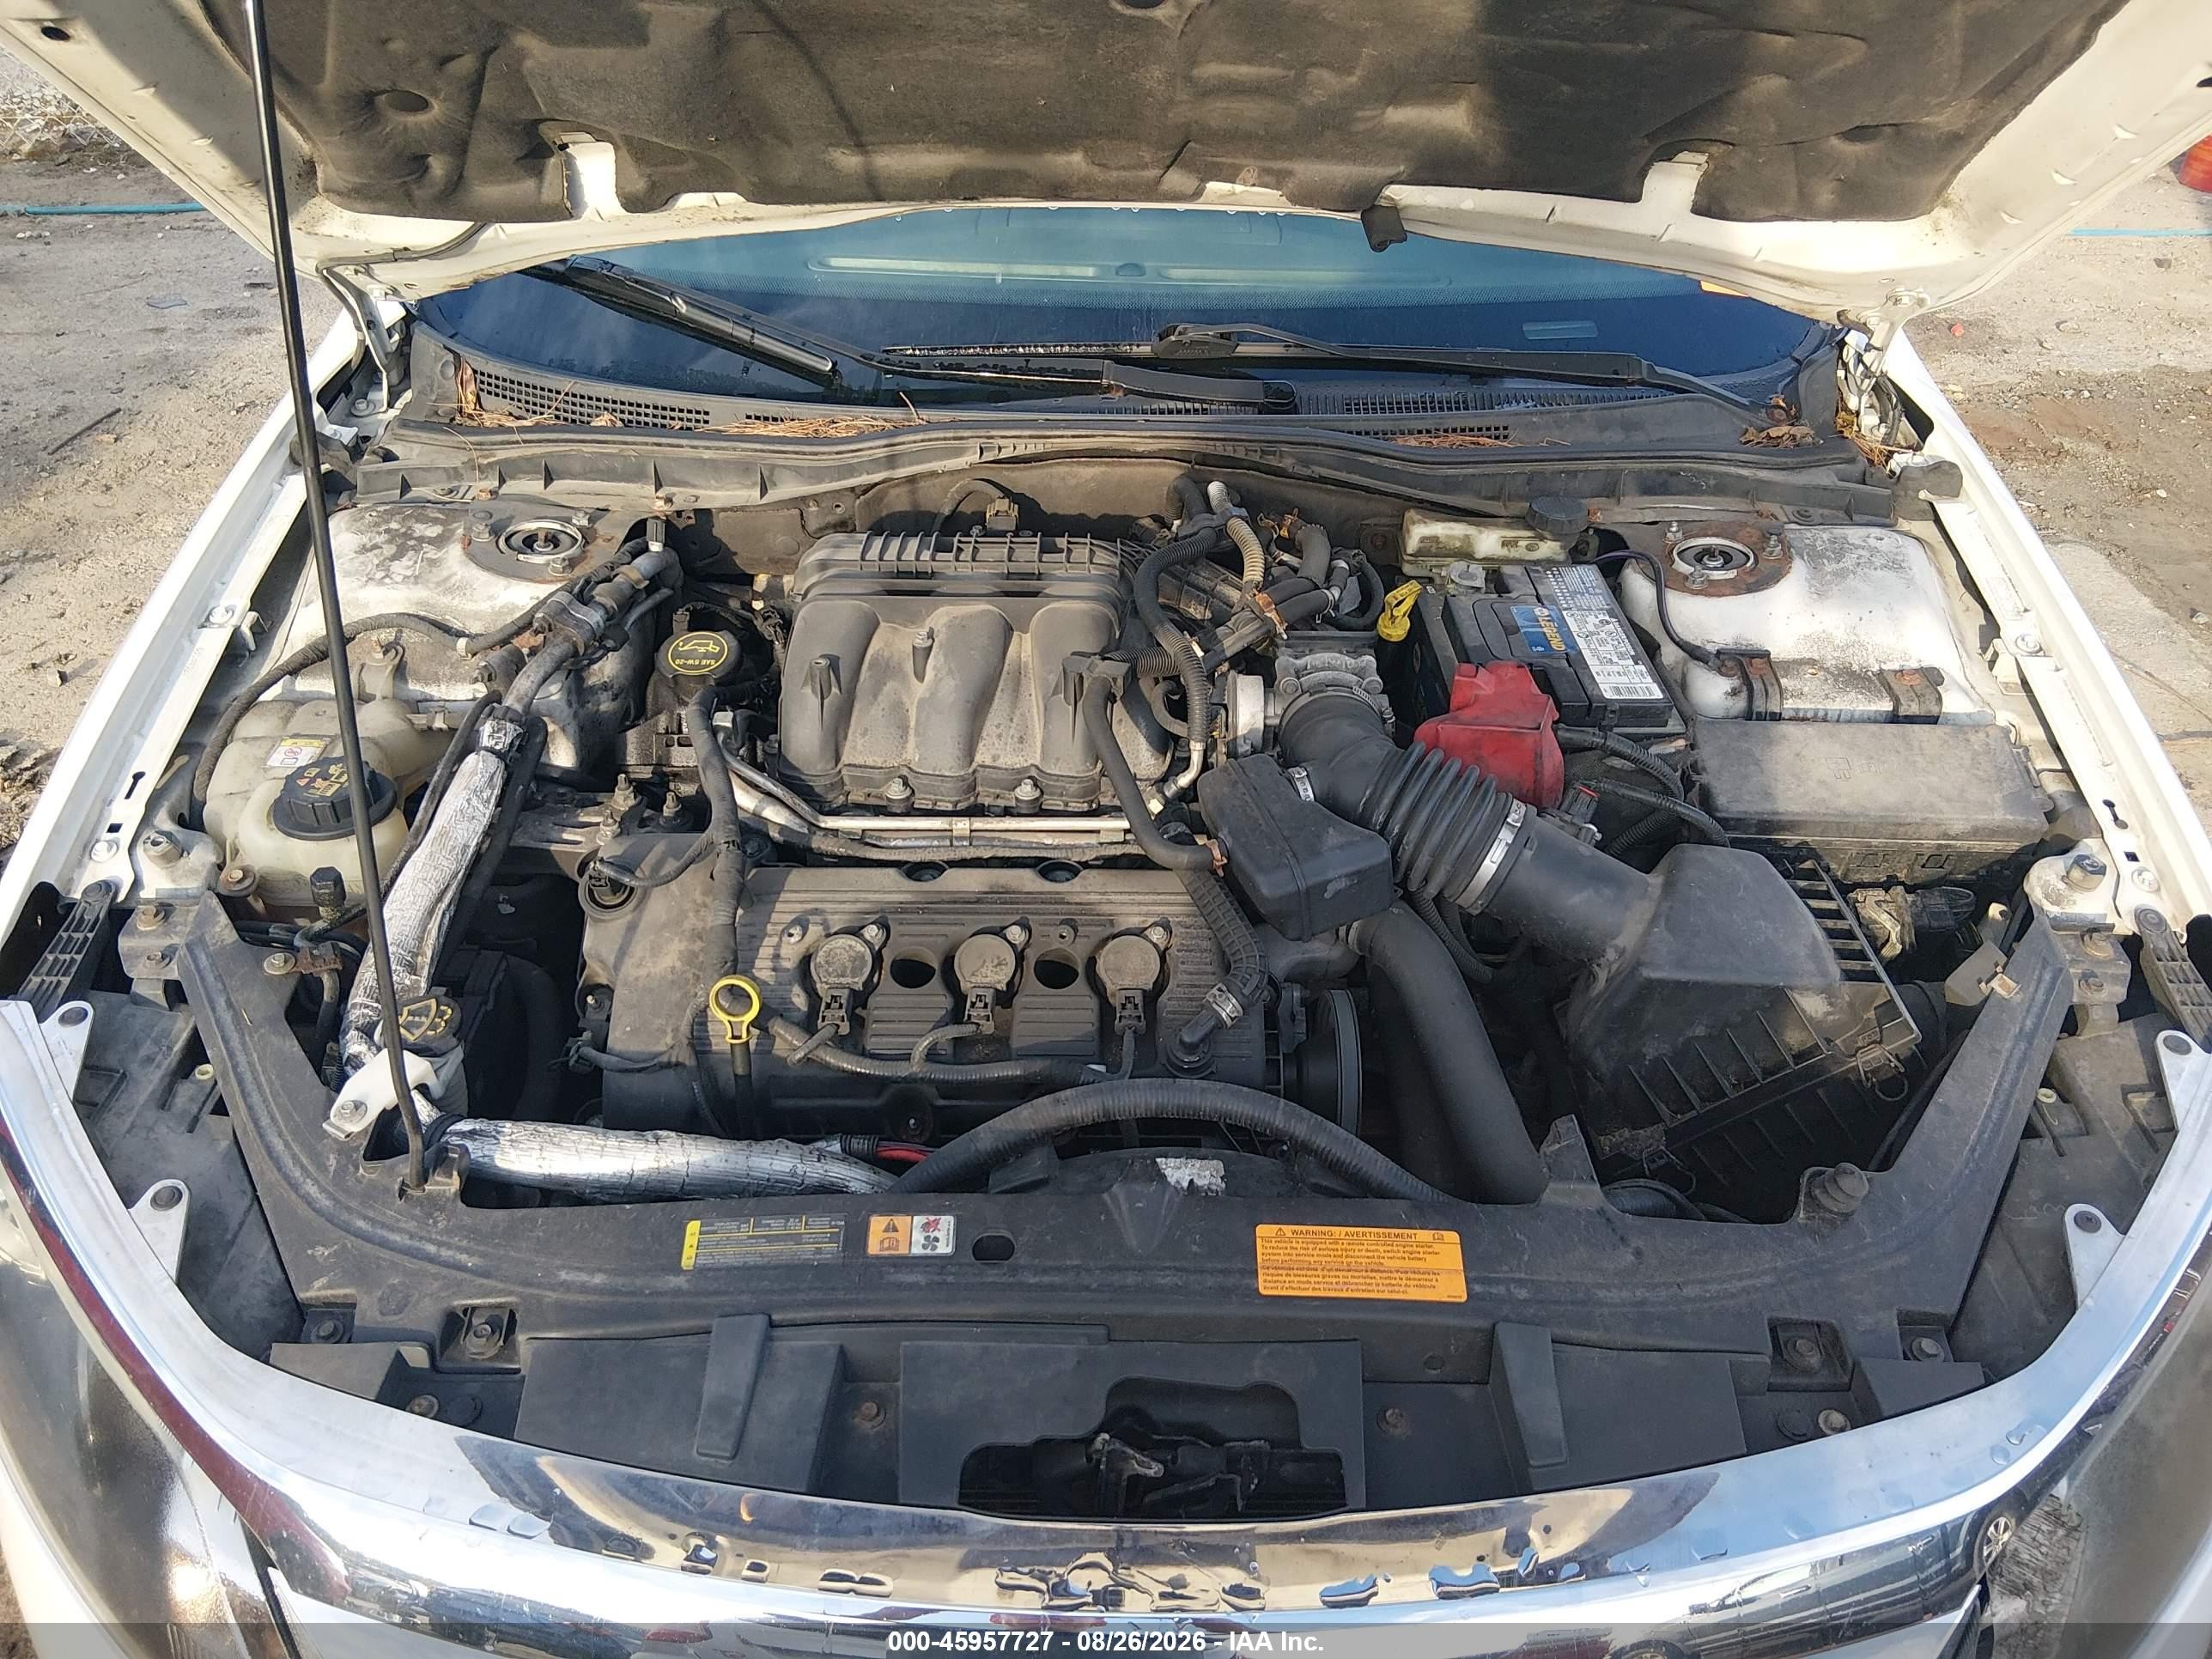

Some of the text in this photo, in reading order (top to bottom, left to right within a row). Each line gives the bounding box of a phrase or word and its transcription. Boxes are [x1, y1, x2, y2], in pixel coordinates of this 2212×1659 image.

[1538, 617, 1566, 651] LEGEND
[1291, 1228, 1336, 1237] WARNING:
[1344, 1231, 1418, 1240] AVERTISSEMENT
